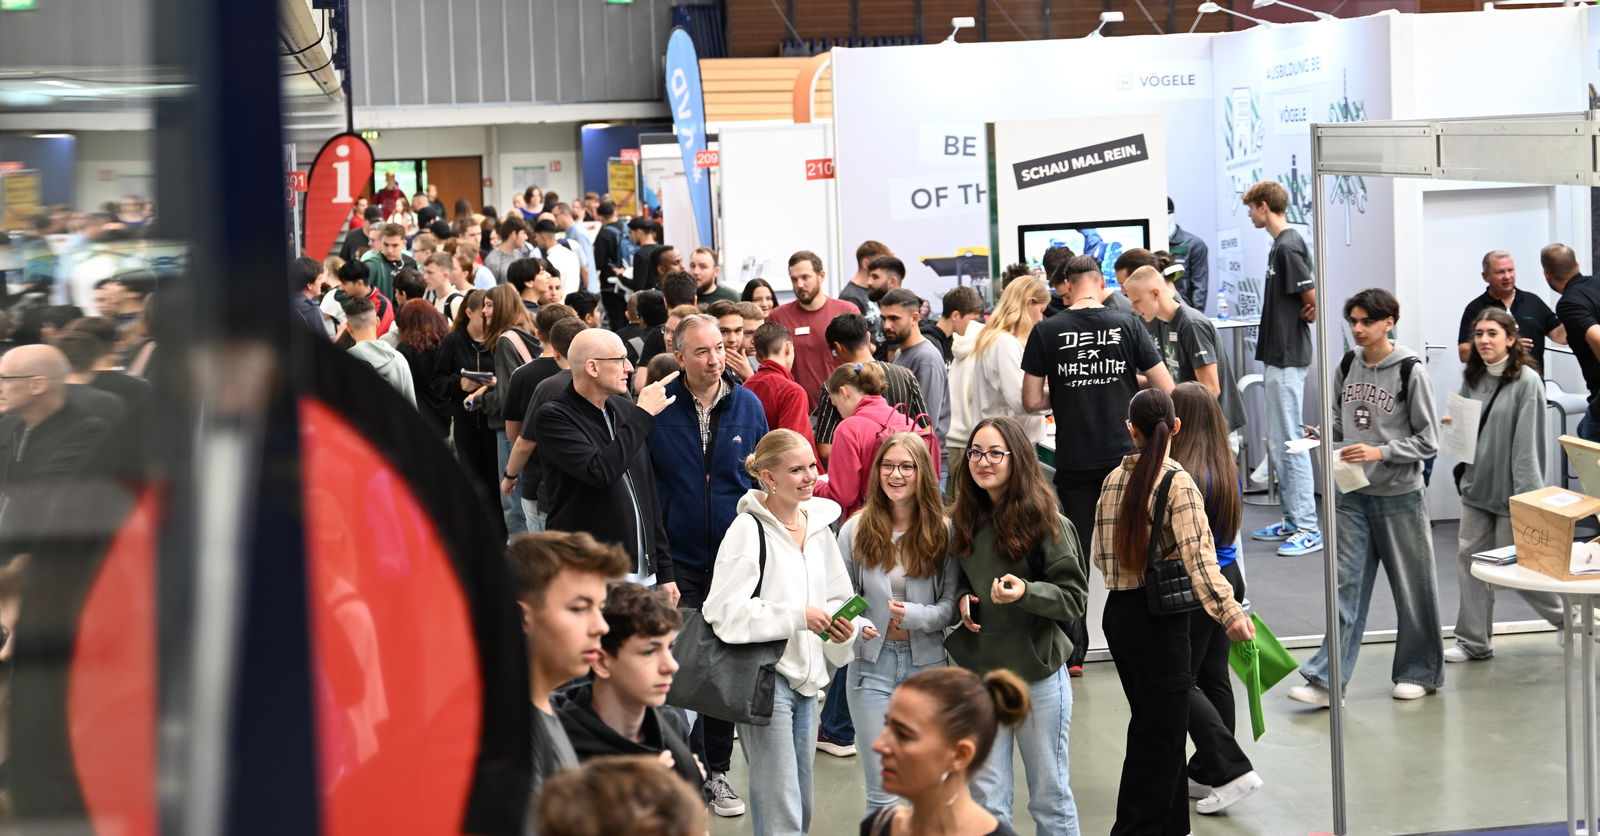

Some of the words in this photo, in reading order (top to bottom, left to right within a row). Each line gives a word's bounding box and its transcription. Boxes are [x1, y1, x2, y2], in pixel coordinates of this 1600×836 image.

[1139, 72, 1196, 87] VÖGELE
[1279, 105, 1307, 123] VÖGELE
[944, 135, 977, 157] BE
[697, 152, 718, 164] 209
[1021, 160, 1070, 182] SCHAU
[1071, 153, 1103, 170] MAL
[1103, 144, 1142, 162] REIN.
[807, 161, 833, 176] 210
[911, 186, 948, 210] OF
[1058, 327, 1122, 350] DEUS
[1077, 350, 1101, 360] EX
[1058, 358, 1127, 377] MACHINA
[1071, 377, 1112, 387] SPECIALS
